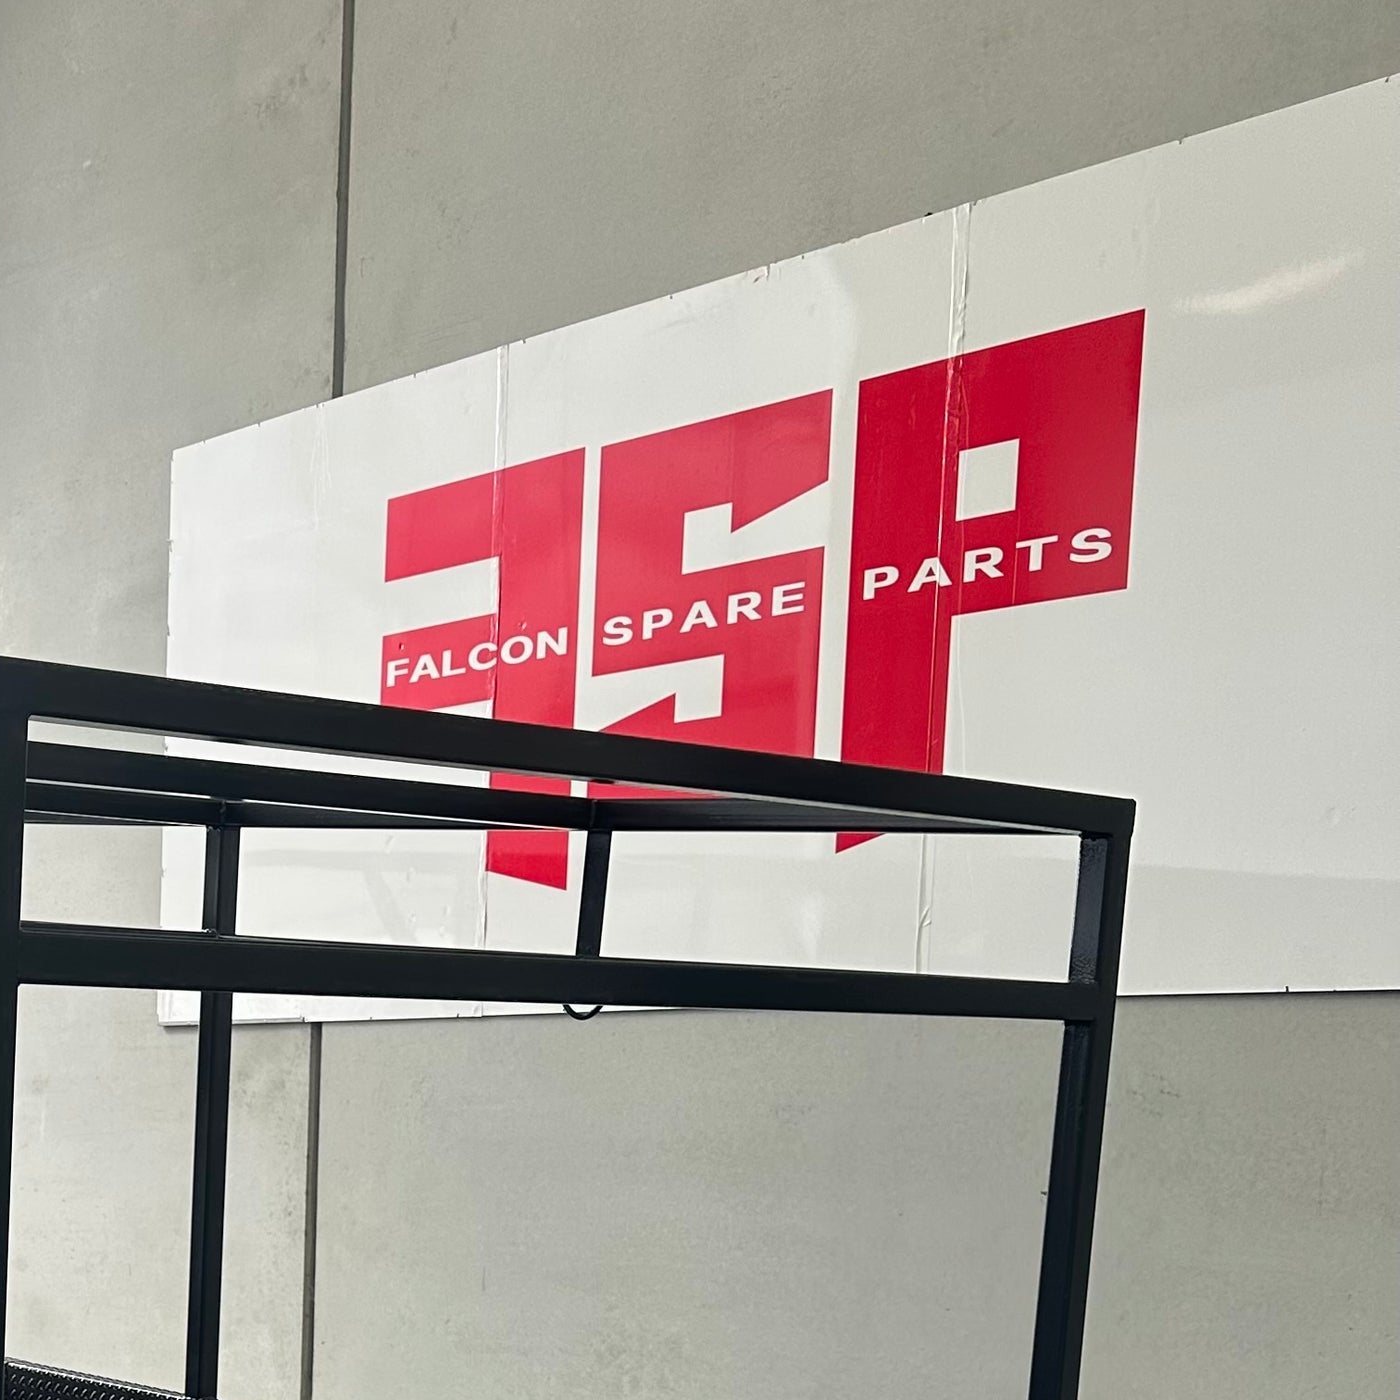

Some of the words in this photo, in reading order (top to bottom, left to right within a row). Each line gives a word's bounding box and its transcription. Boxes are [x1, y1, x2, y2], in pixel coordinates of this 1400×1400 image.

[386, 626, 569, 688] FALCON
[602, 581, 806, 646] SPARE
[863, 527, 1113, 601] PARTS
